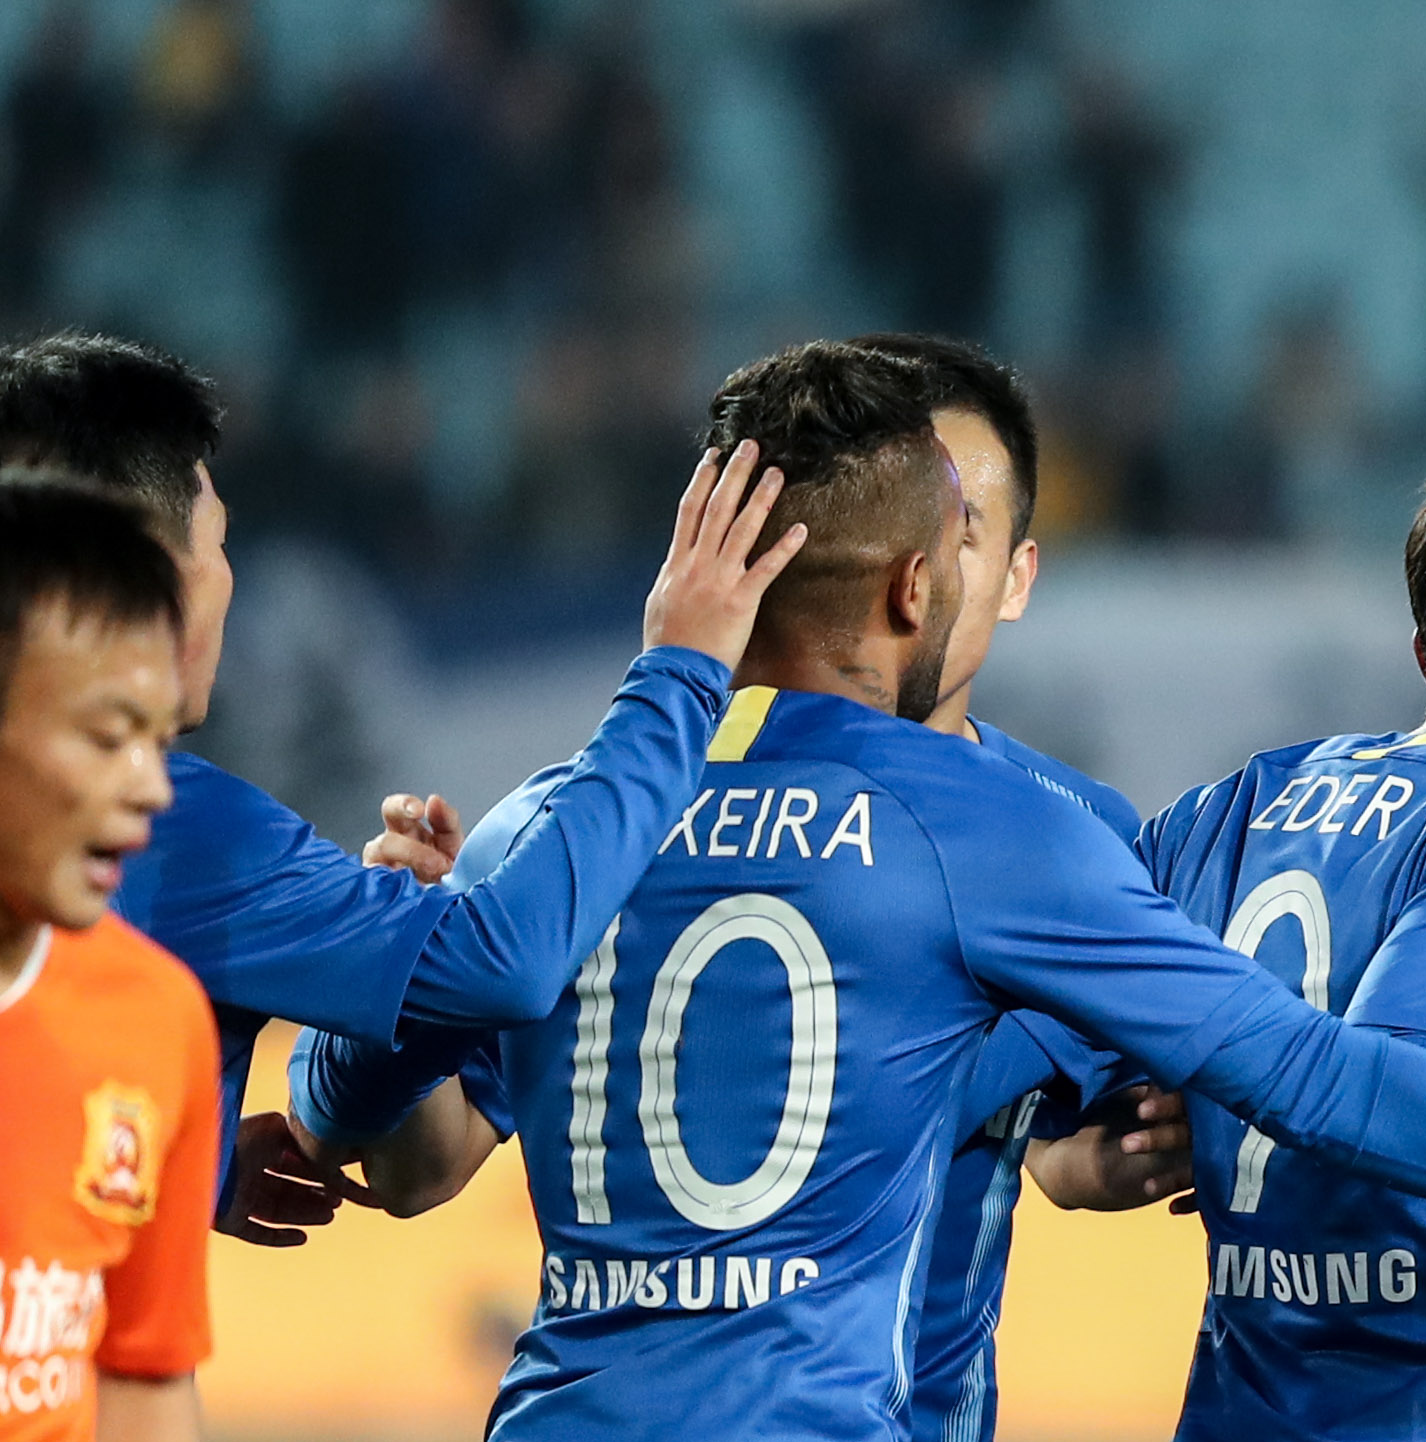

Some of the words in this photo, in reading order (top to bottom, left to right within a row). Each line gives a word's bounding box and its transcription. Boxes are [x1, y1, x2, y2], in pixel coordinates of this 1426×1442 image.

[656, 787, 875, 867] XEIRA
[1249, 773, 1414, 841] EDER
[568, 892, 838, 1231] 10
[1214, 1243, 1417, 1306] MSUNG
